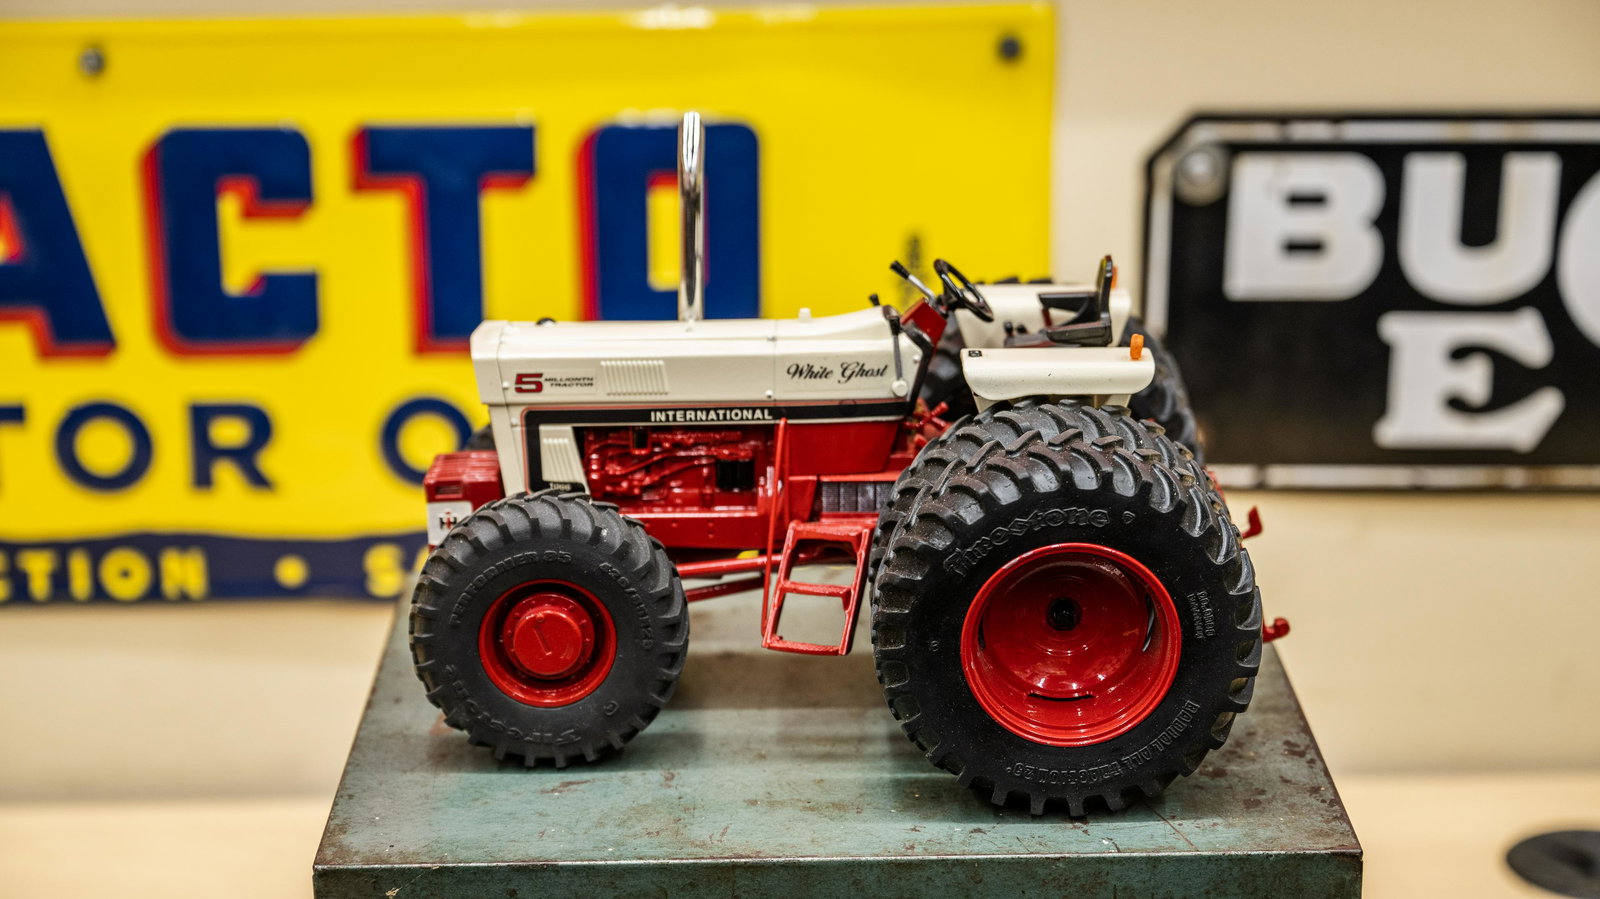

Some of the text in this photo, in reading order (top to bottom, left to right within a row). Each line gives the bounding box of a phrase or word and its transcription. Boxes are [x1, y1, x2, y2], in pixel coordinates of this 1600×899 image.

[514, 373, 543, 393] 5
[786, 361, 889, 384] White Ghost
[1372, 306, 1565, 453] E
[650, 408, 773, 422] INTERNATIONAL
[0, 546, 208, 602] TION
[1152, 700, 1201, 751] RADIAL
[1120, 745, 1153, 770] ALL
